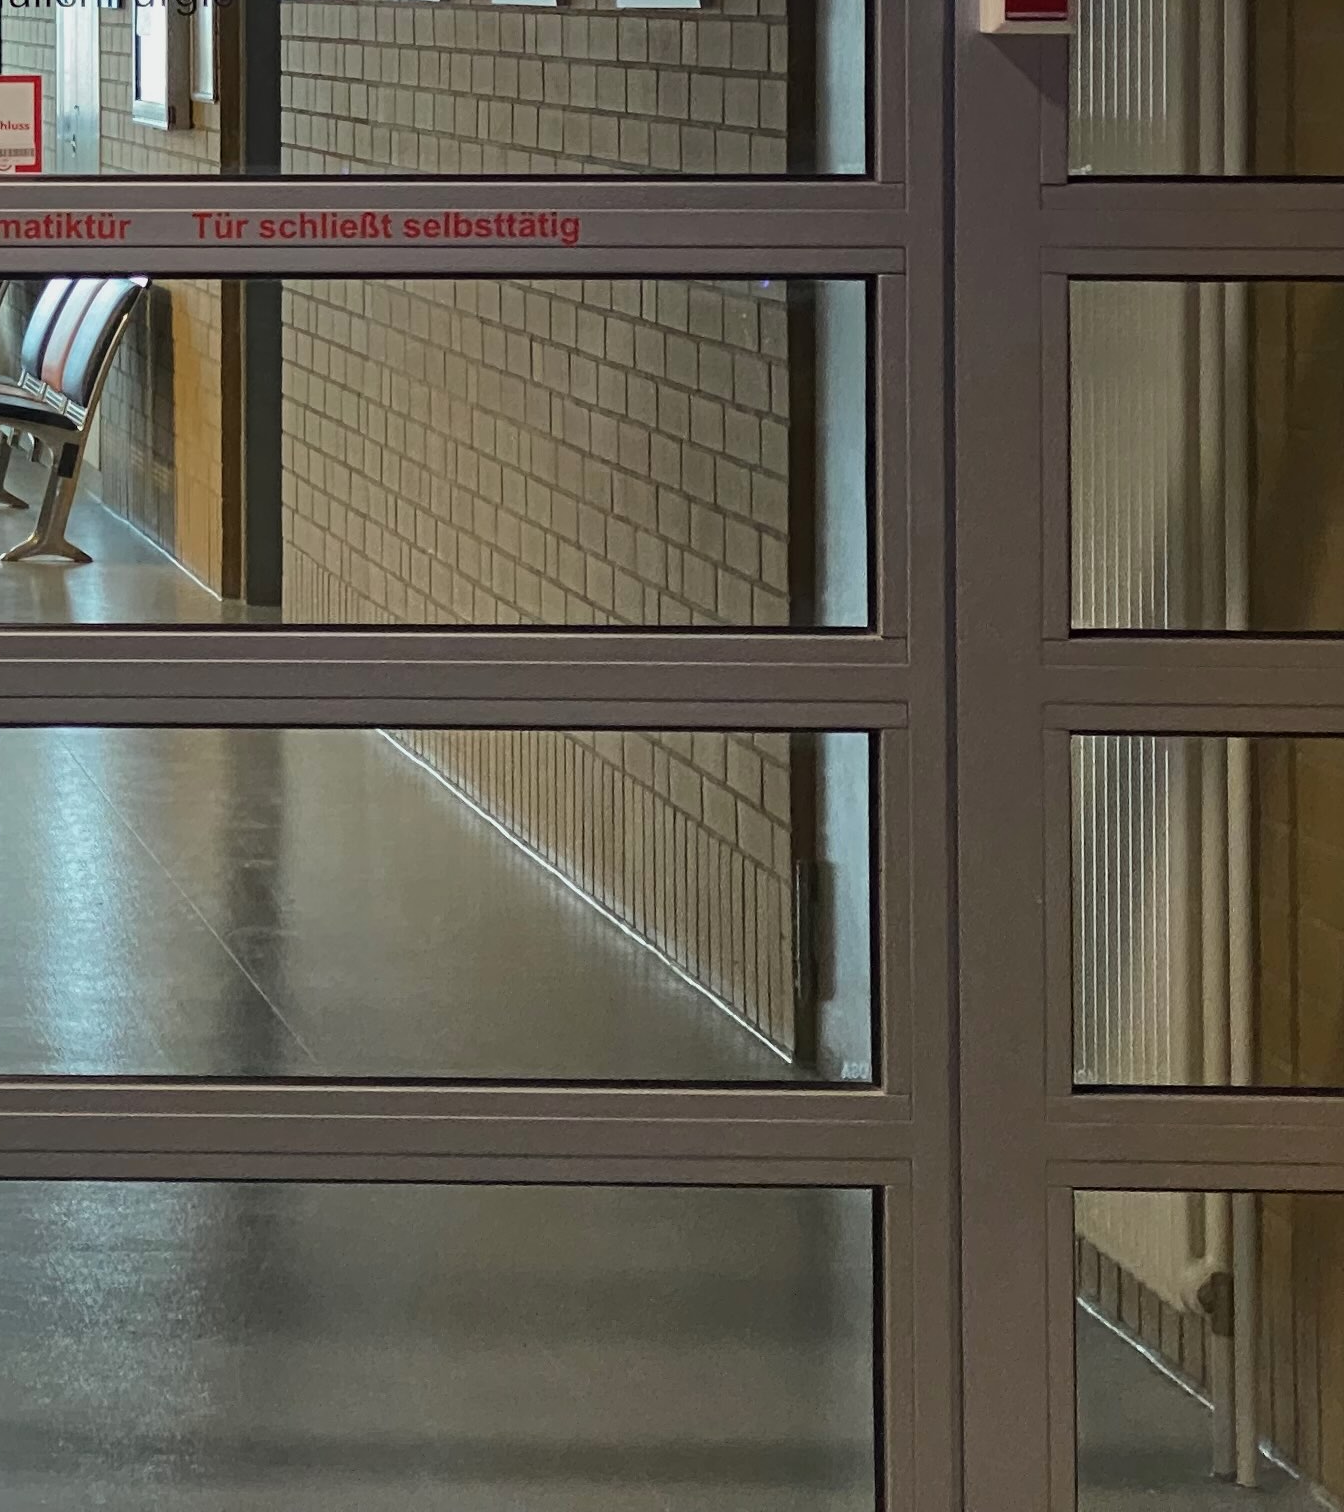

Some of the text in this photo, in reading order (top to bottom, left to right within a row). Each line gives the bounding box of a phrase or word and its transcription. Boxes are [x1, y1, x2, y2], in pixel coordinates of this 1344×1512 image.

[192, 211, 249, 240] Tür
[259, 211, 392, 240] schließt
[402, 211, 581, 245] selbsttätig
